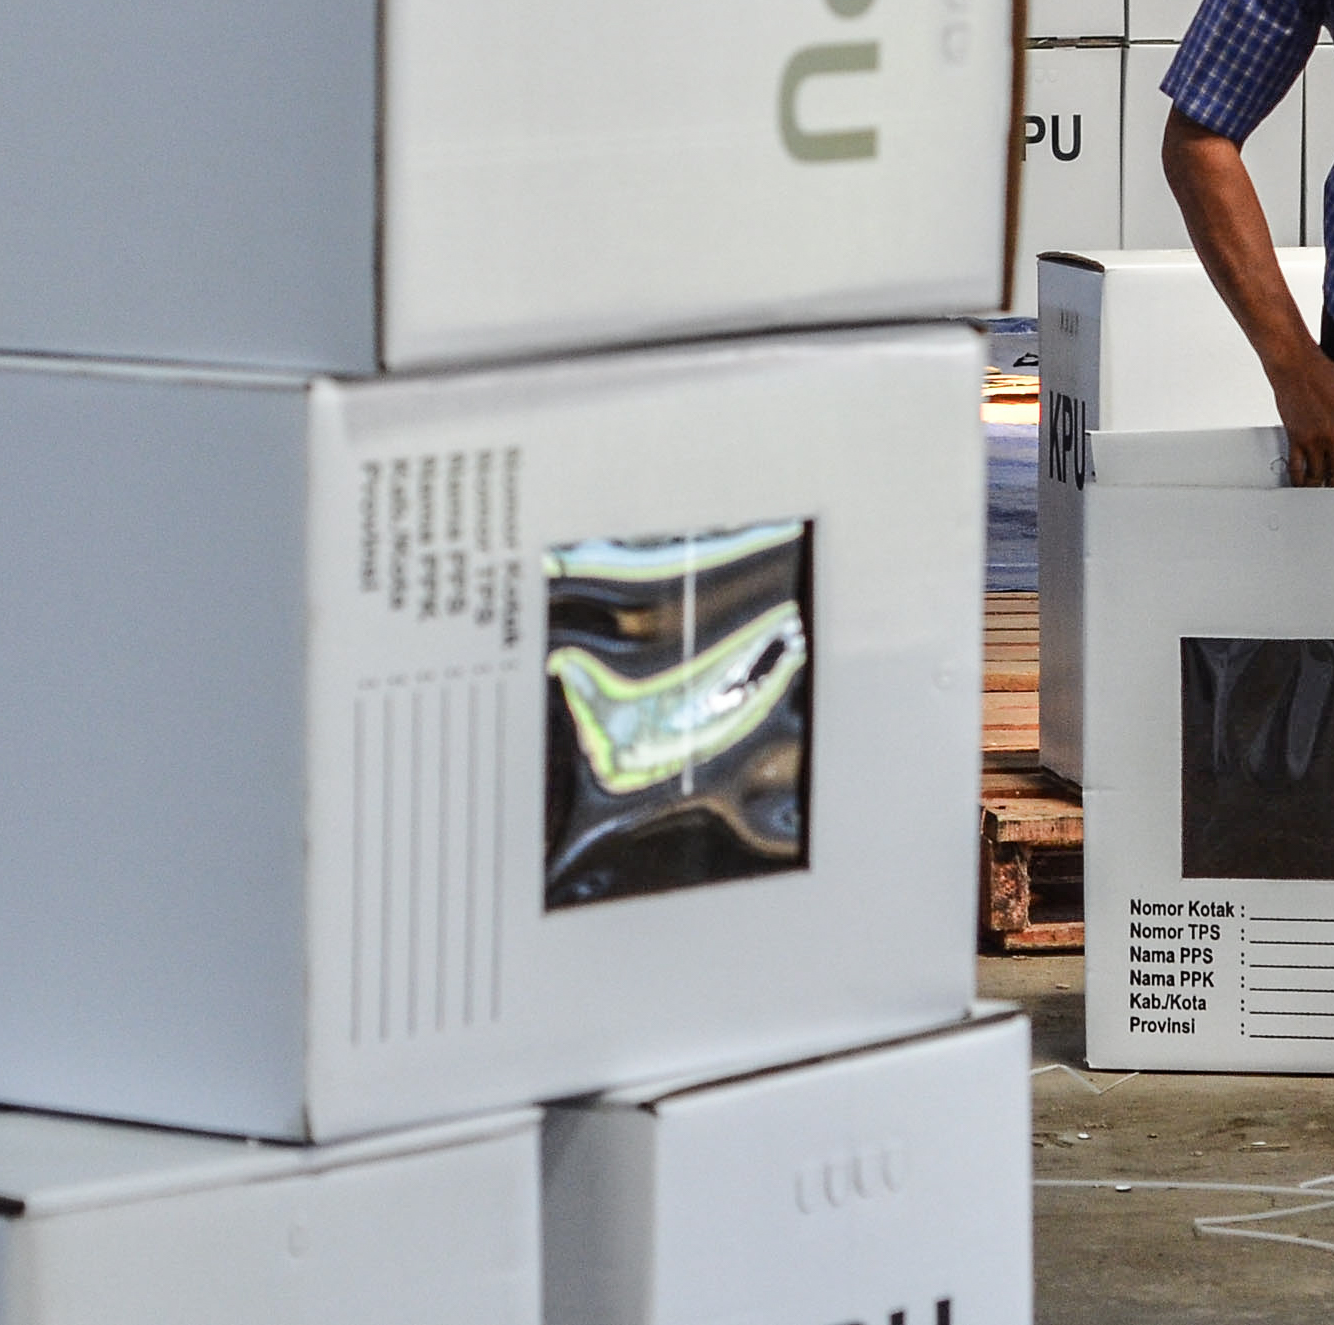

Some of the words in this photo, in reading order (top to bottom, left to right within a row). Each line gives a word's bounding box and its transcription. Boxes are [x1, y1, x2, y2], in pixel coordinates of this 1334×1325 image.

[1022, 114, 1082, 162] PU
[1049, 390, 1086, 491] KPU
[1130, 899, 1184, 918] Nomor
[1188, 899, 1235, 918] Kotak
[1130, 923, 1184, 941] Nomor
[1188, 923, 1221, 941] TPS
[1130, 946, 1175, 965] Nama
[1180, 946, 1214, 965] PPS
[1130, 970, 1175, 988] Nama
[1179, 970, 1215, 988] PPK
[1129, 993, 1207, 1011] Kab./Kota
[1129, 1016, 1196, 1035] Provinsi
